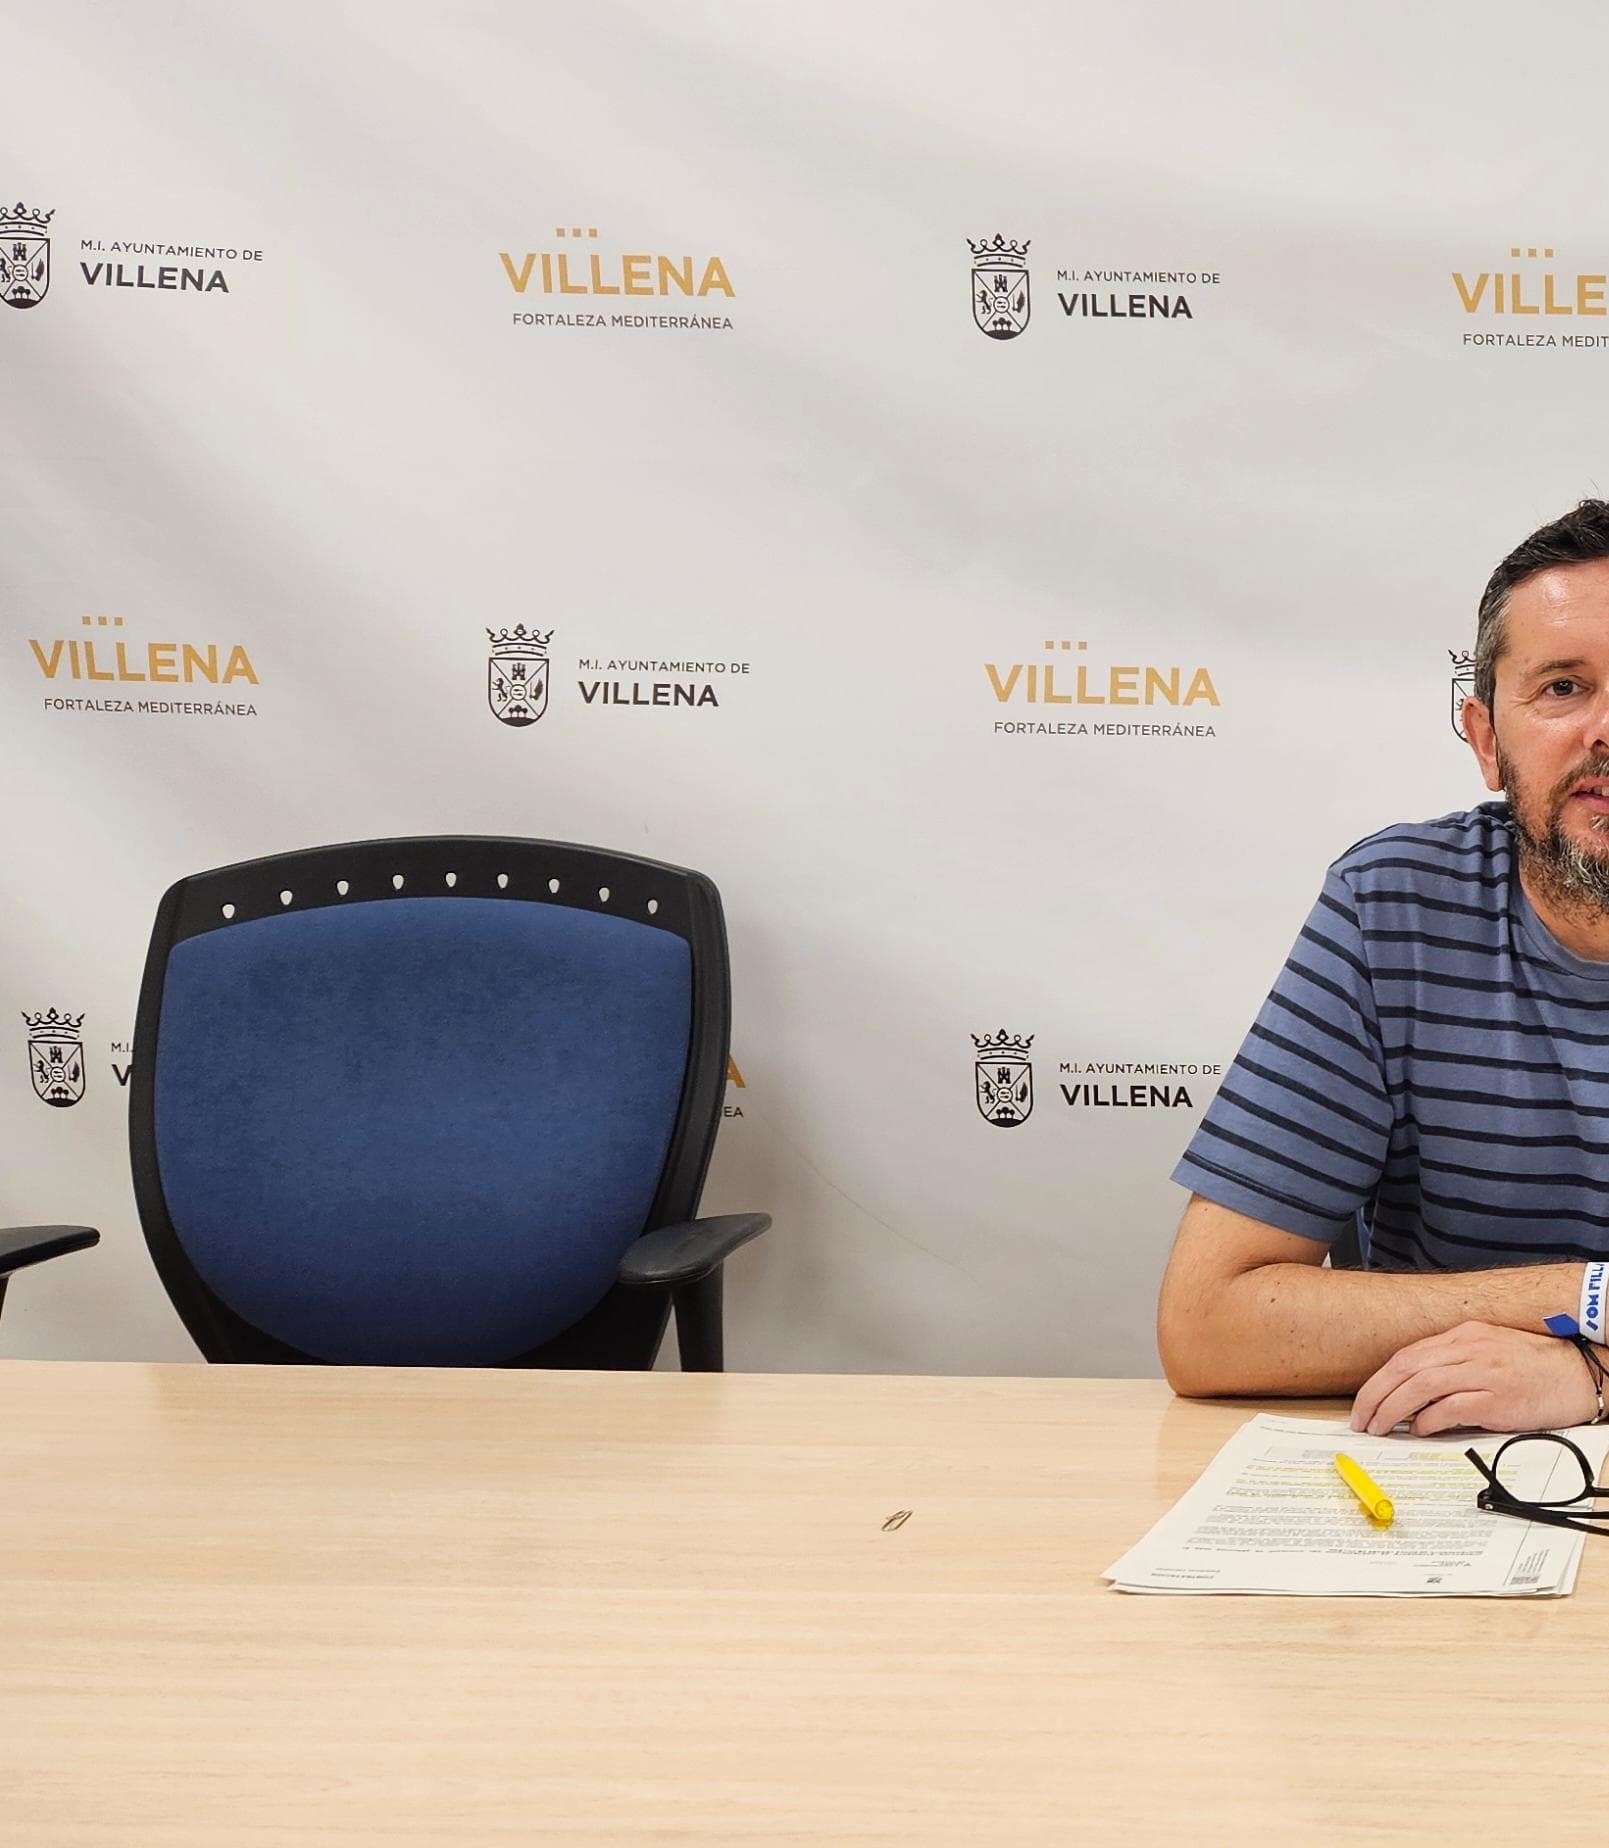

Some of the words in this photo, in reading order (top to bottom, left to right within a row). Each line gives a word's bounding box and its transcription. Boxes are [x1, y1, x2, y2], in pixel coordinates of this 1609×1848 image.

[80, 241, 106, 252] M.I.
[111, 241, 239, 261] AYUNTAMIENTO
[243, 249, 264, 262] DE
[79, 261, 230, 294] VILLENA
[498, 252, 737, 298] VILLENA
[1056, 269, 1080, 282] M.I.
[1083, 270, 1197, 284] AYUNTAMIENTO
[1201, 272, 1221, 285] DE
[1056, 292, 1194, 320] VILLENA
[512, 312, 607, 327] FORTALEZA
[611, 315, 734, 330] MEDITERRÁNEA
[1463, 333, 1557, 348] FORTALEZA
[28, 639, 260, 685] VILLENA
[578, 658, 604, 672] M.I.
[607, 659, 728, 675] AYUNTAMIENTO
[731, 662, 750, 675] DE
[577, 680, 720, 708] VILLENA
[984, 663, 1221, 707] VILLENA
[44, 698, 134, 714] FORTALEZA
[138, 700, 258, 717] MEDITERRÁNEA
[994, 721, 1089, 736] FORTALEZA
[1093, 721, 1217, 738] MEDITERRÁNEA
[1059, 1062, 1082, 1074] M.I.
[1085, 1062, 1199, 1075] AYUNTAMIENTO
[1202, 1063, 1222, 1076] DE
[1059, 1083, 1194, 1109] VILLENA
